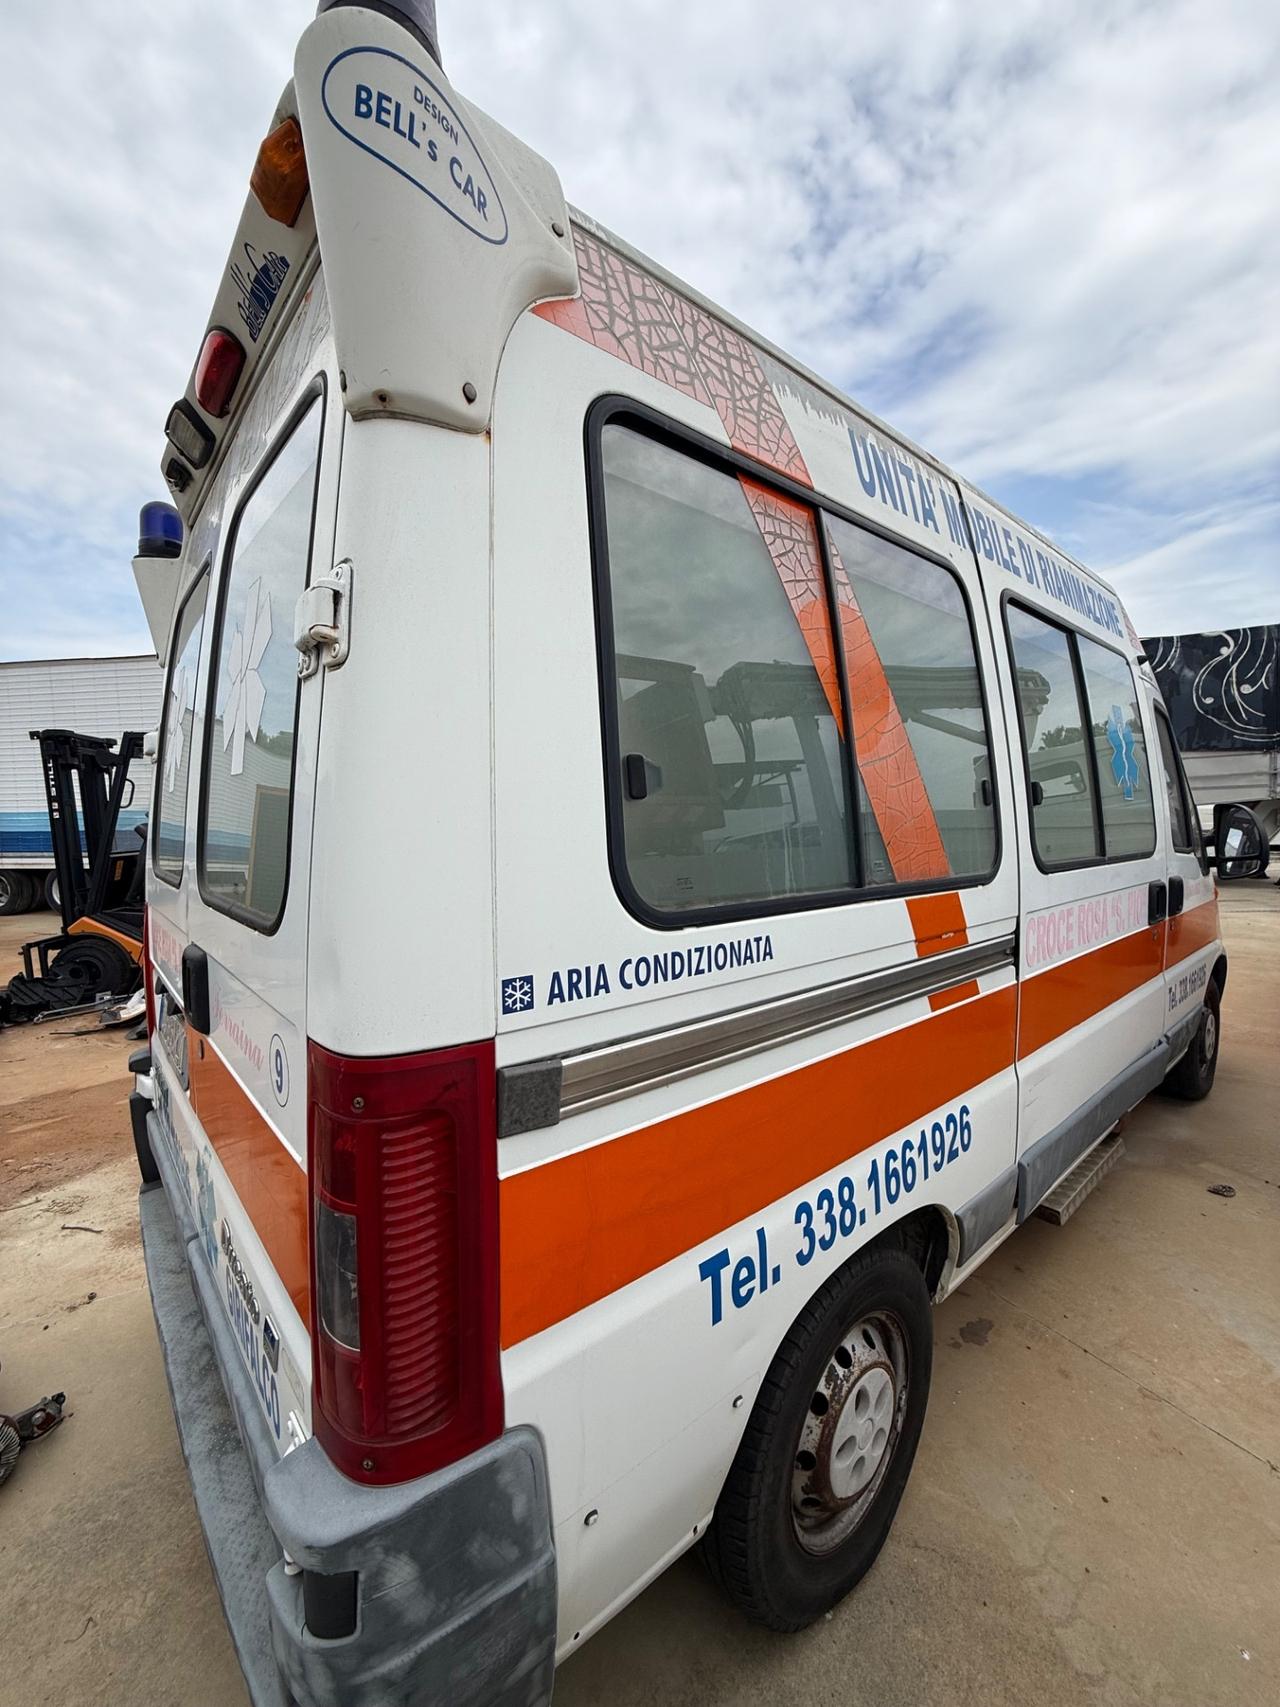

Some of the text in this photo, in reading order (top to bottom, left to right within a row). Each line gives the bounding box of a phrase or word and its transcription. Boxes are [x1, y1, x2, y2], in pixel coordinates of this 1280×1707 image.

[414, 85, 459, 146] DESIGN
[450, 156, 489, 222] CAR
[939, 487, 1022, 579] MOBILE
[1017, 534, 1040, 590] DI
[1036, 549, 1124, 639] RIANIMAZIONE
[47, 759, 57, 797] STILL
[1025, 907, 1074, 968] CROCE
[1077, 896, 1109, 947] ROSA
[547, 935, 774, 1006] ARIA CONDIZIONATA
[1168, 983, 1177, 1012] Tel.
[275, 1048, 283, 1094] 9
[698, 1104, 972, 1327] Tel. 338.1661926
